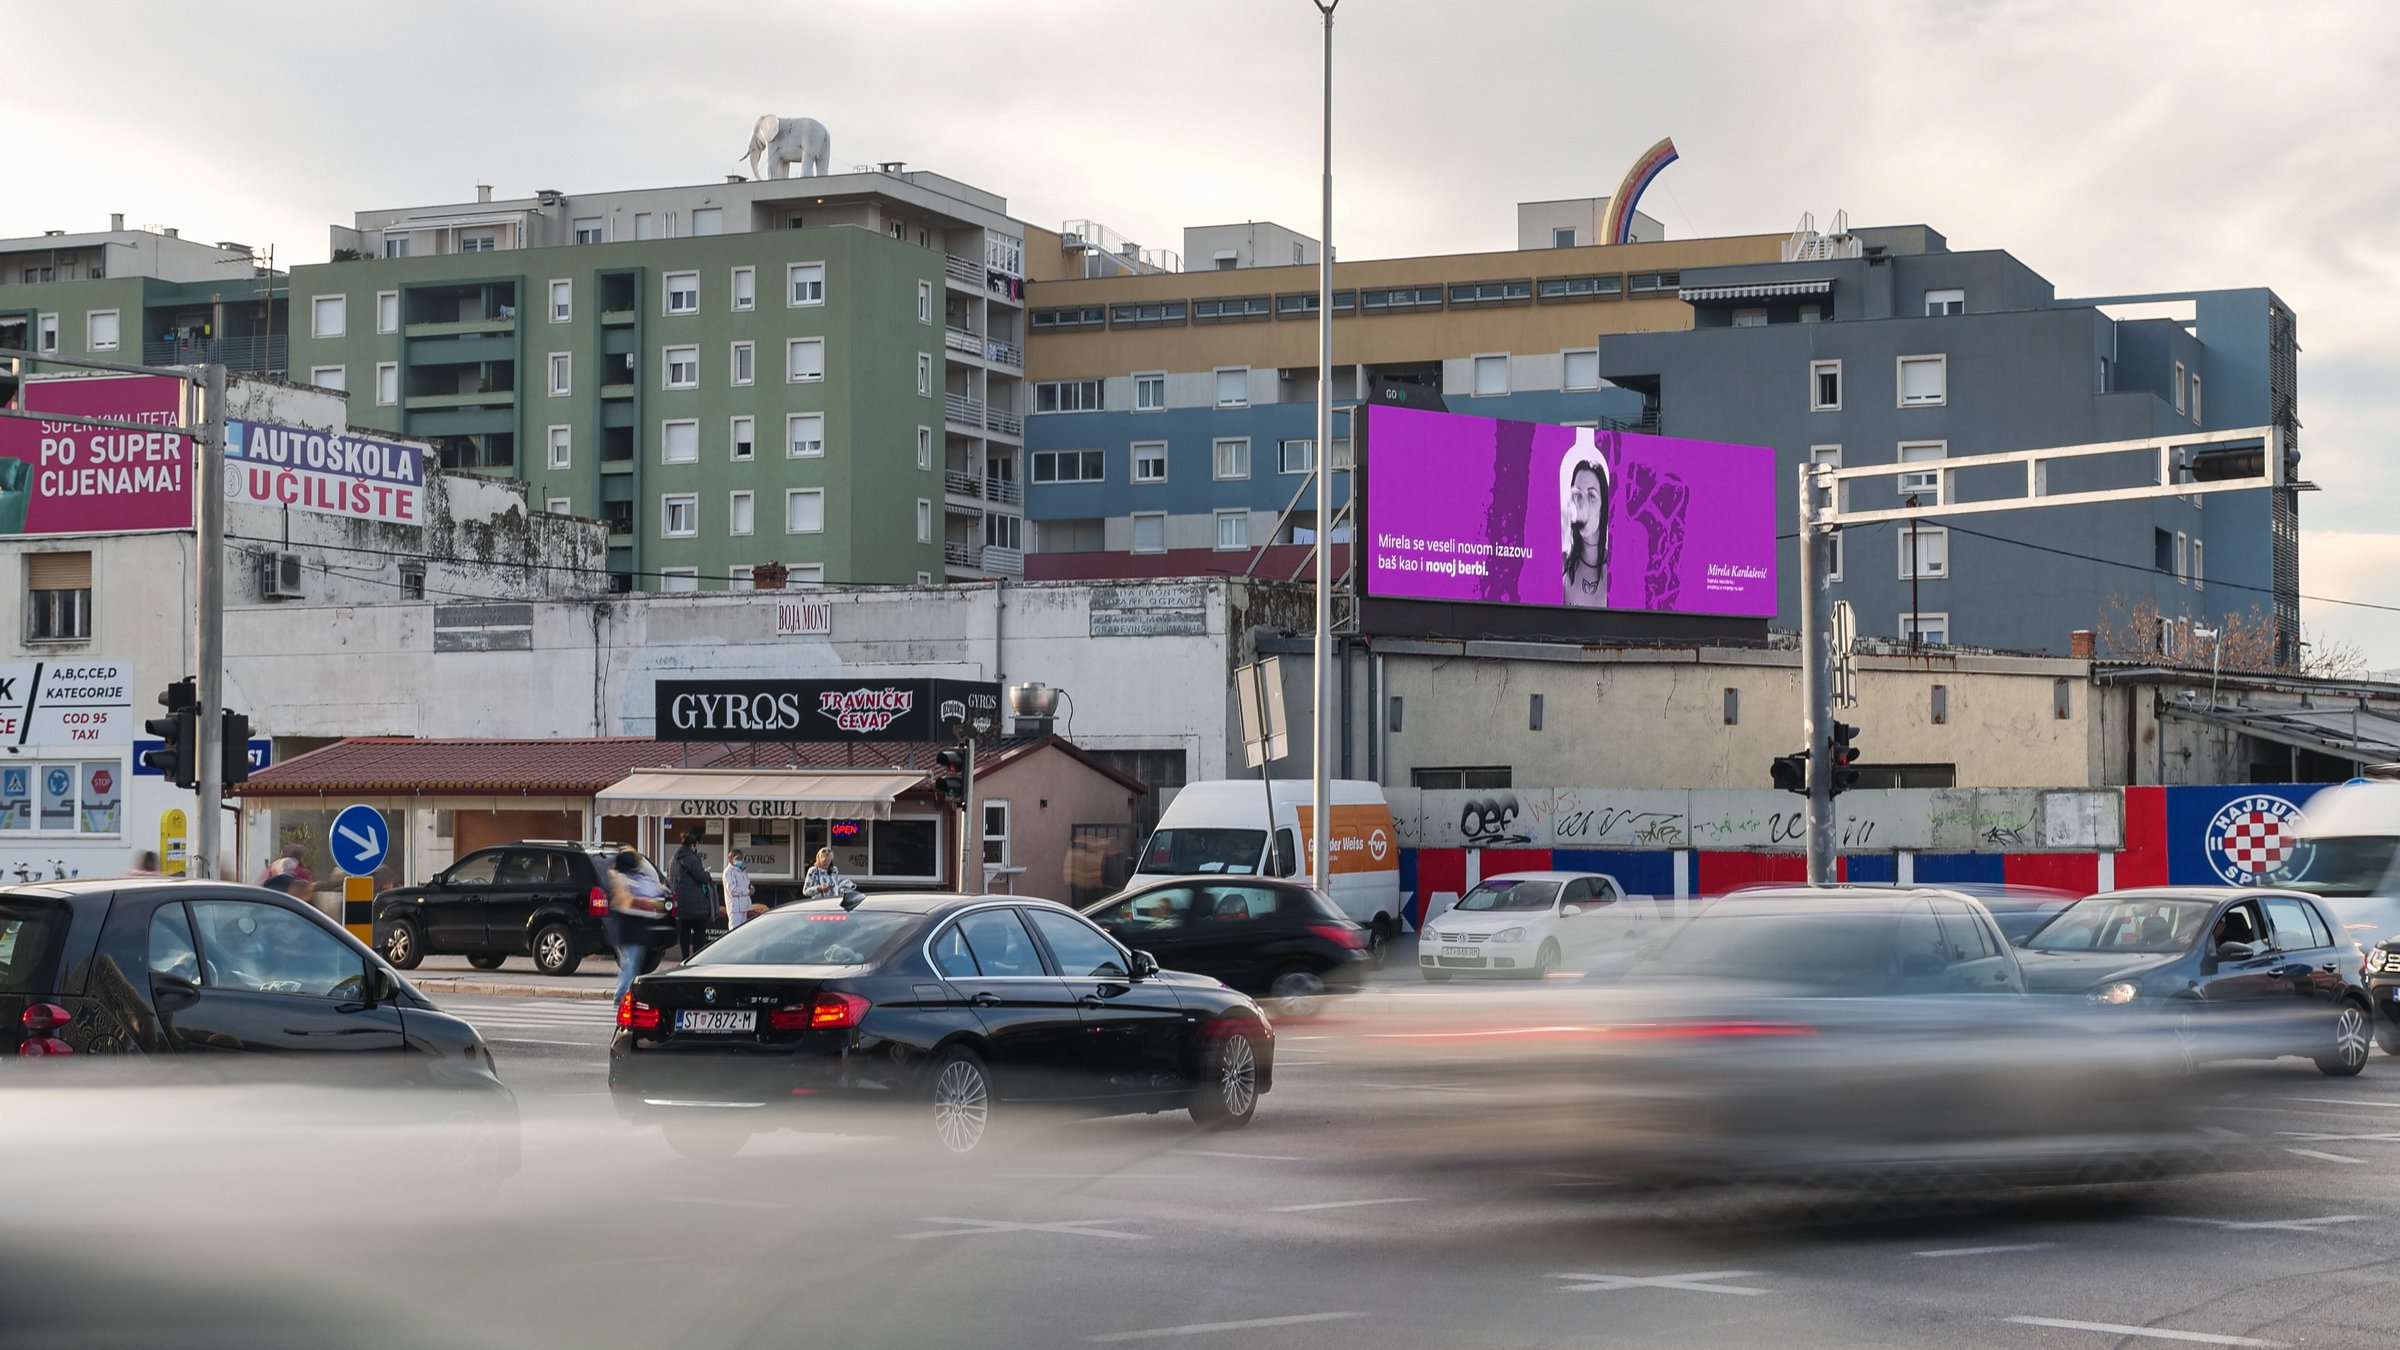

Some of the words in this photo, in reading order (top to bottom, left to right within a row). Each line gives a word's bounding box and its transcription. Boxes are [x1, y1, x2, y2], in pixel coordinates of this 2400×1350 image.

[40, 437, 76, 467] PO
[89, 432, 181, 464] SUPER
[249, 427, 415, 482] AUTOŠKOLA
[40, 464, 182, 497] CIJENAMA!
[249, 466, 413, 519] UČILIŠTE
[1378, 533, 1411, 550] Mirela
[1413, 540, 1425, 551] se
[1427, 539, 1456, 553] veseli
[1458, 543, 1493, 556] novom
[1495, 542, 1533, 559] izazovu
[1378, 554, 1397, 570] baš
[1399, 556, 1418, 571] kao
[1420, 557, 1424, 571] i
[1426, 559, 1456, 577] novoj
[1458, 560, 1489, 576] berbi.
[1707, 563, 1730, 577] Mirela
[779, 604, 801, 633] BOJA
[803, 604, 829, 630] MONT
[52, 667, 117, 680] A,B,C,CE,D
[46, 687, 123, 699] KATEGORIJE
[819, 687, 913, 711] TRAVNIČKI
[63, 713, 90, 724] COD
[93, 713, 107, 723] 95
[71, 729, 99, 740] TAXI
[94, 778, 111, 788] STOP
[680, 799, 739, 816] GYROS
[748, 800, 803, 817] GRILL
[2215, 798, 2302, 831] HAJDUK
[832, 825, 857, 835] OPEN
[1343, 836, 1364, 851] Weiss
[2224, 865, 2293, 887] SPLIT
[684, 1012, 700, 1028] ST
[707, 1012, 752, 1029] 7872-M
